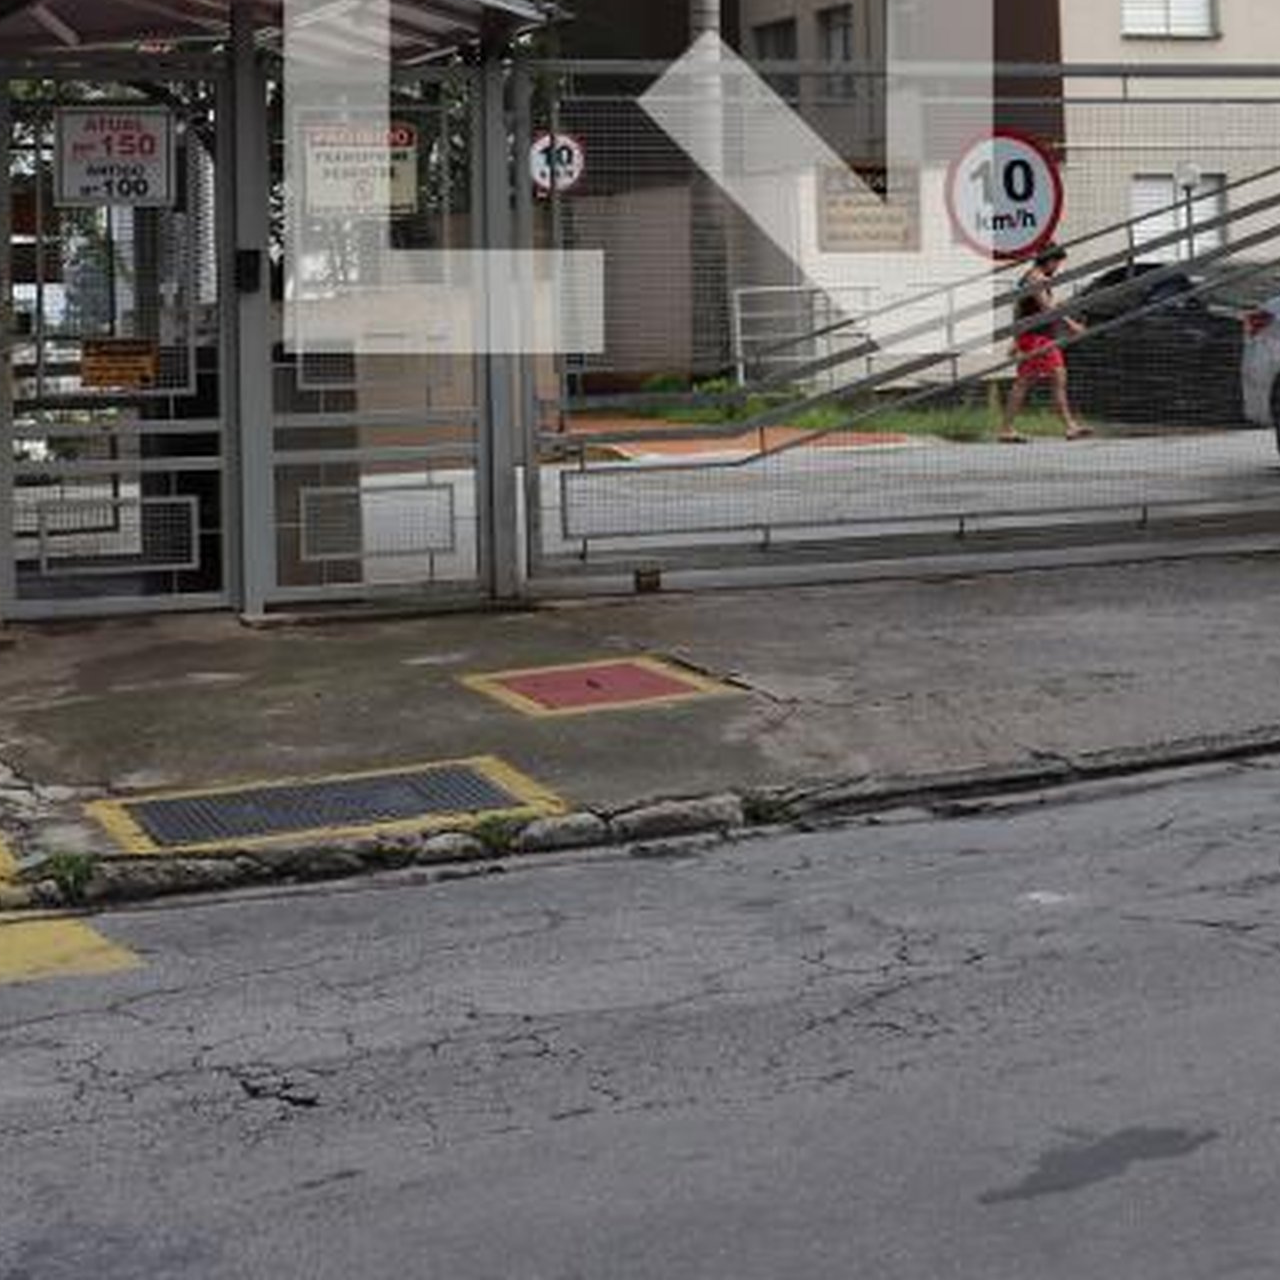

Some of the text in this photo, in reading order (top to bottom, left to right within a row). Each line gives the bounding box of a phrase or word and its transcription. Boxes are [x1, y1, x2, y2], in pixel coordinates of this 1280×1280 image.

[101, 133, 156, 156] 150
[103, 178, 149, 197] 100
[968, 158, 1036, 205] 10
